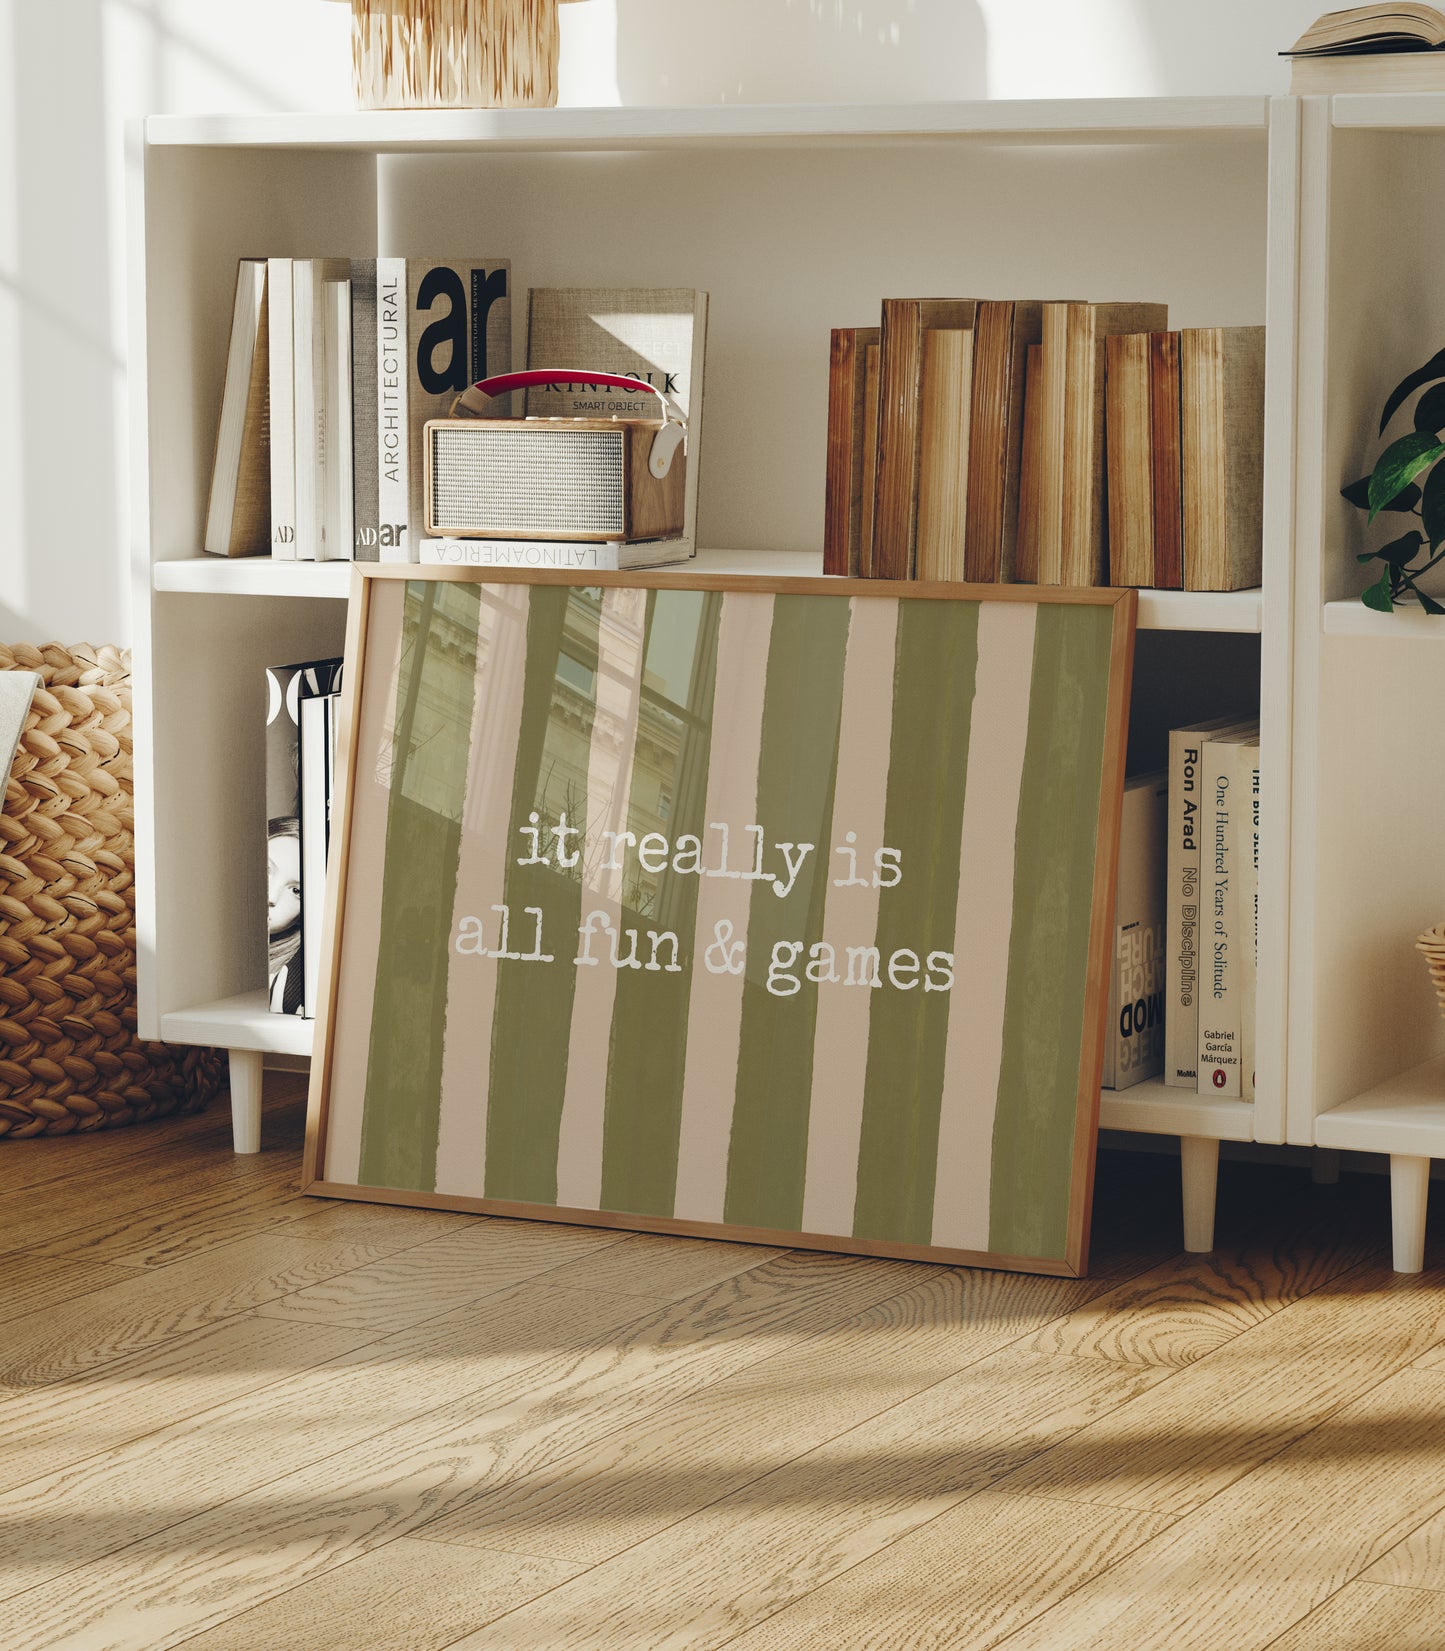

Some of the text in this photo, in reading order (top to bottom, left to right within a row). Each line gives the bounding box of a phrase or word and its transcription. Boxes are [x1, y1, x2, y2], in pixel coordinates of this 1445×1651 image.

[416, 266, 507, 395] ar
[383, 277, 399, 482] ARCHITECTURAL
[573, 401, 646, 411] SMART OBJECT
[274, 525, 294, 543] AD
[356, 527, 377, 546] AD
[380, 523, 407, 547] ar
[436, 544, 598, 567] LATINOAMERICA
[516, 810, 903, 898] it really is
[1178, 749, 1198, 1006] Ron Arad No Discipline
[1213, 775, 1229, 999] One Hundred Years of Solitude
[454, 904, 955, 997] all fun & games
[1120, 992, 1163, 1039] MOD
[1204, 1030, 1235, 1040] Gabriel
[1205, 1042, 1232, 1052] García
[1201, 1054, 1238, 1065] Márquez
[1176, 1069, 1196, 1078] MoMA
